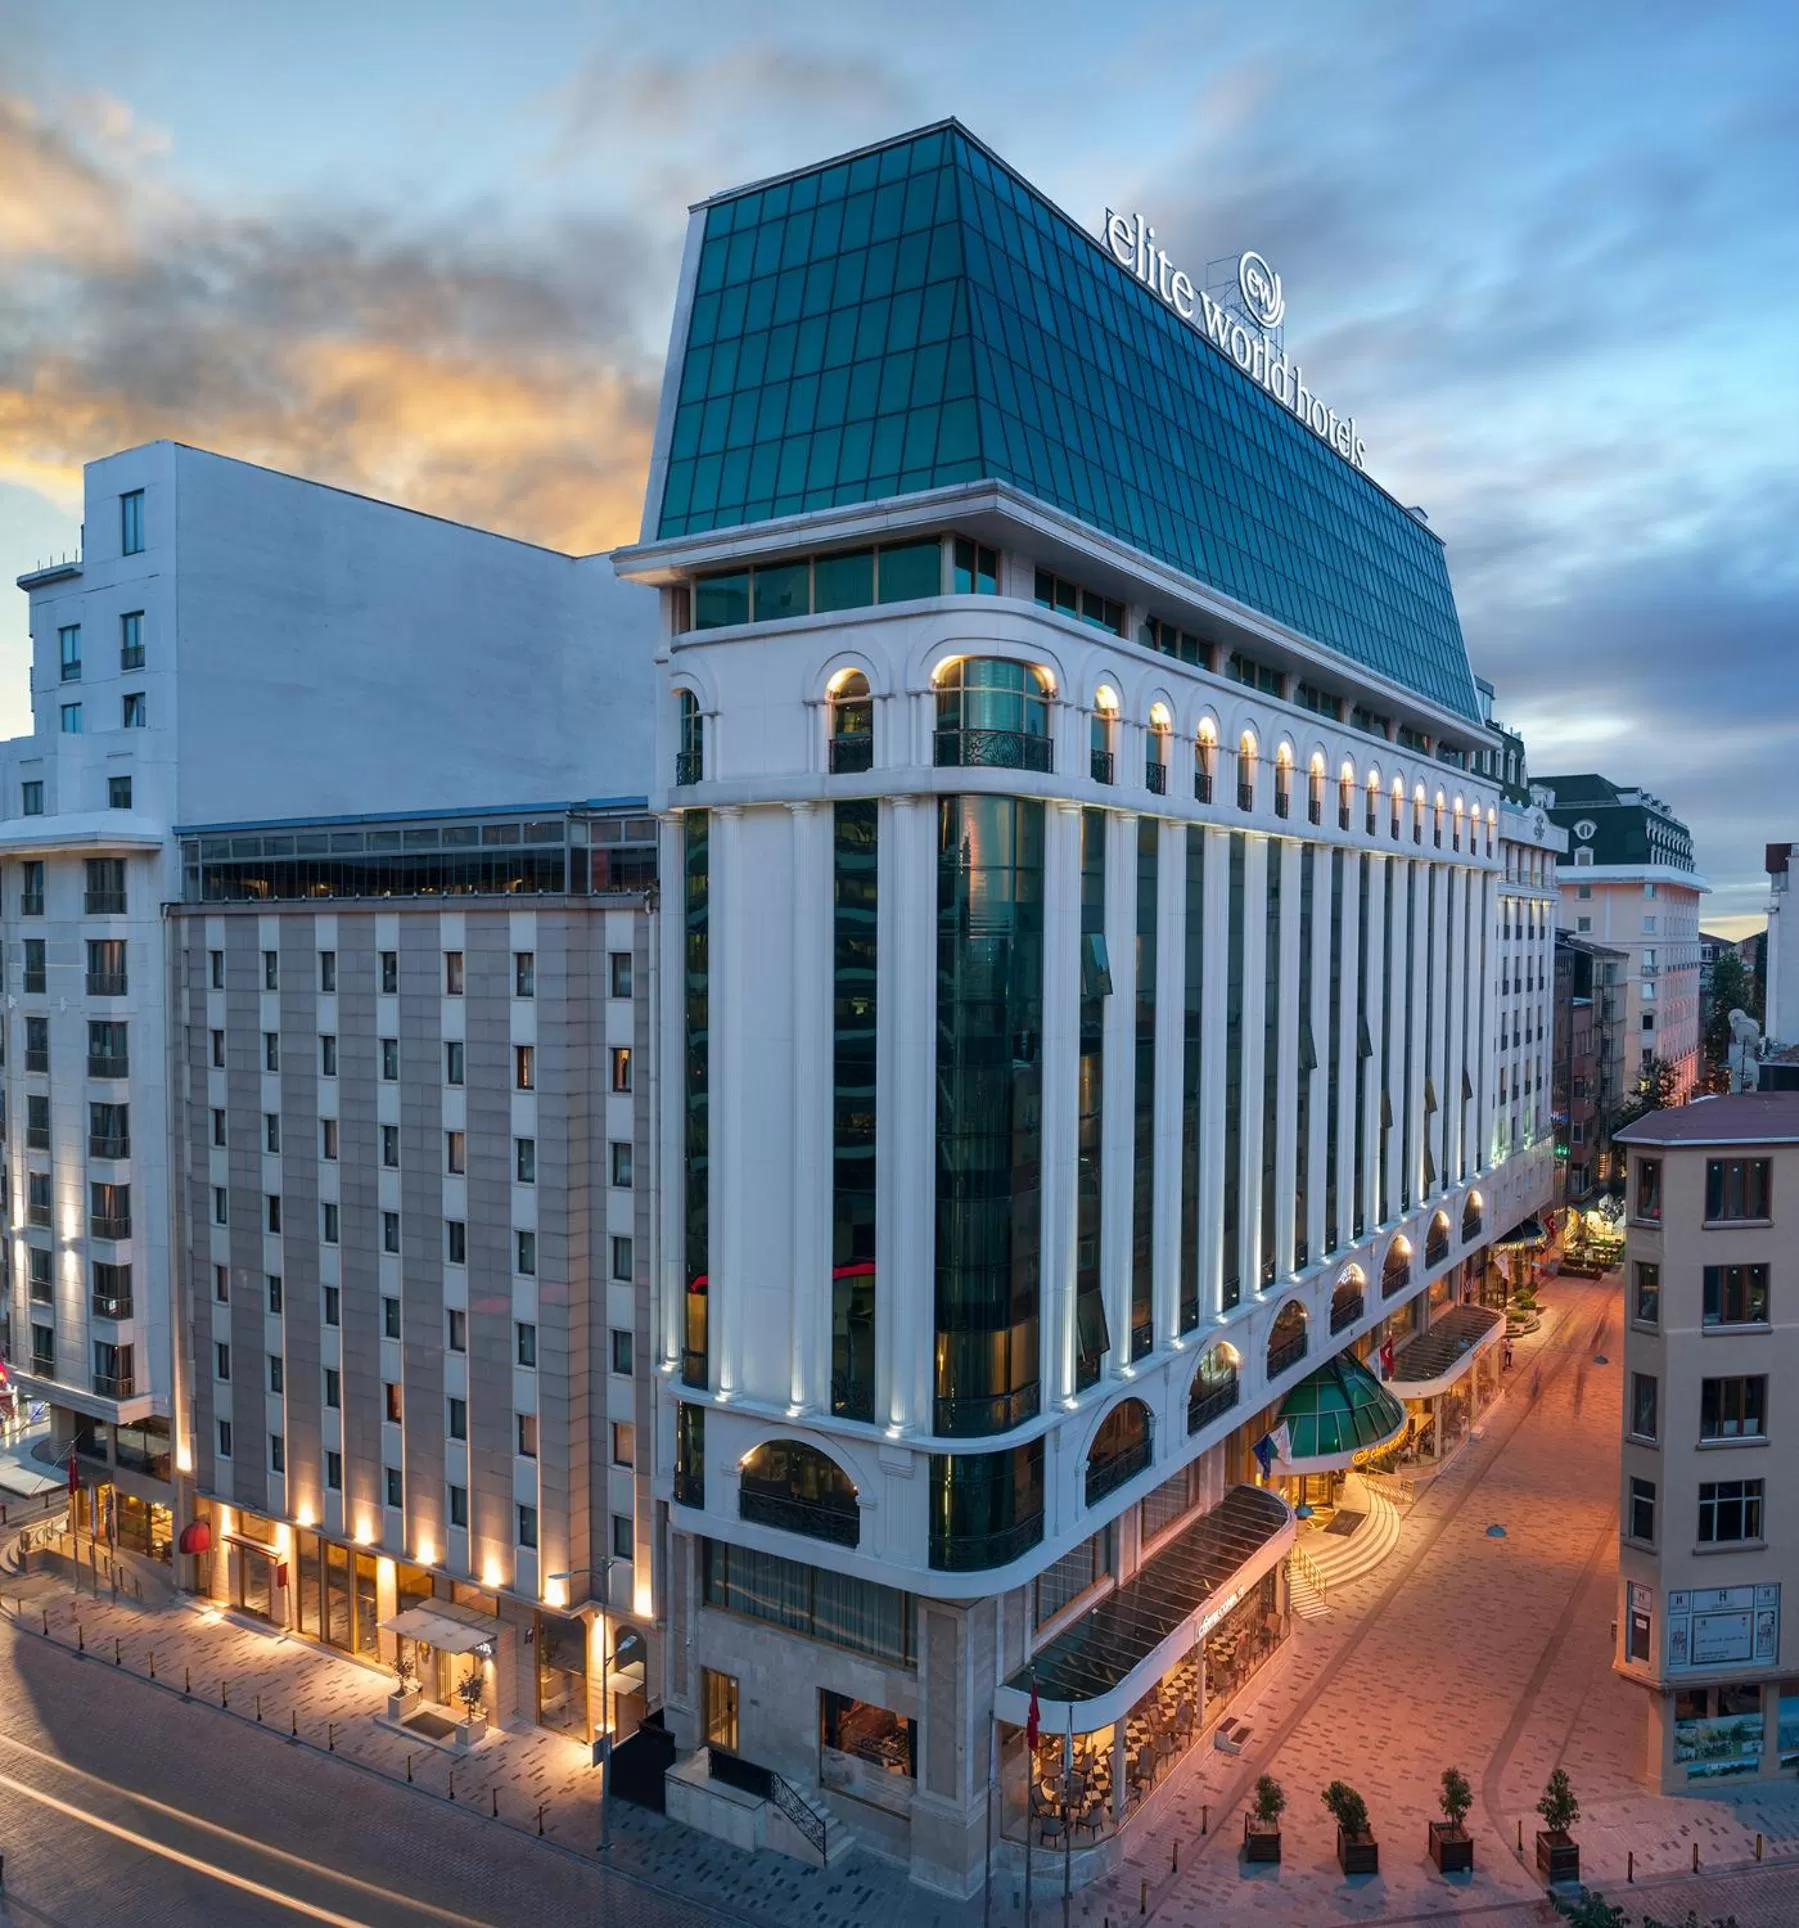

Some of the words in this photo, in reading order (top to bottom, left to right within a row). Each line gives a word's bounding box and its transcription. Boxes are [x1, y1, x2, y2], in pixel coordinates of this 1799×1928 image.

[1106, 213, 1194, 318] elite
[1199, 290, 1289, 402] world
[1294, 366, 1366, 471] hotels
